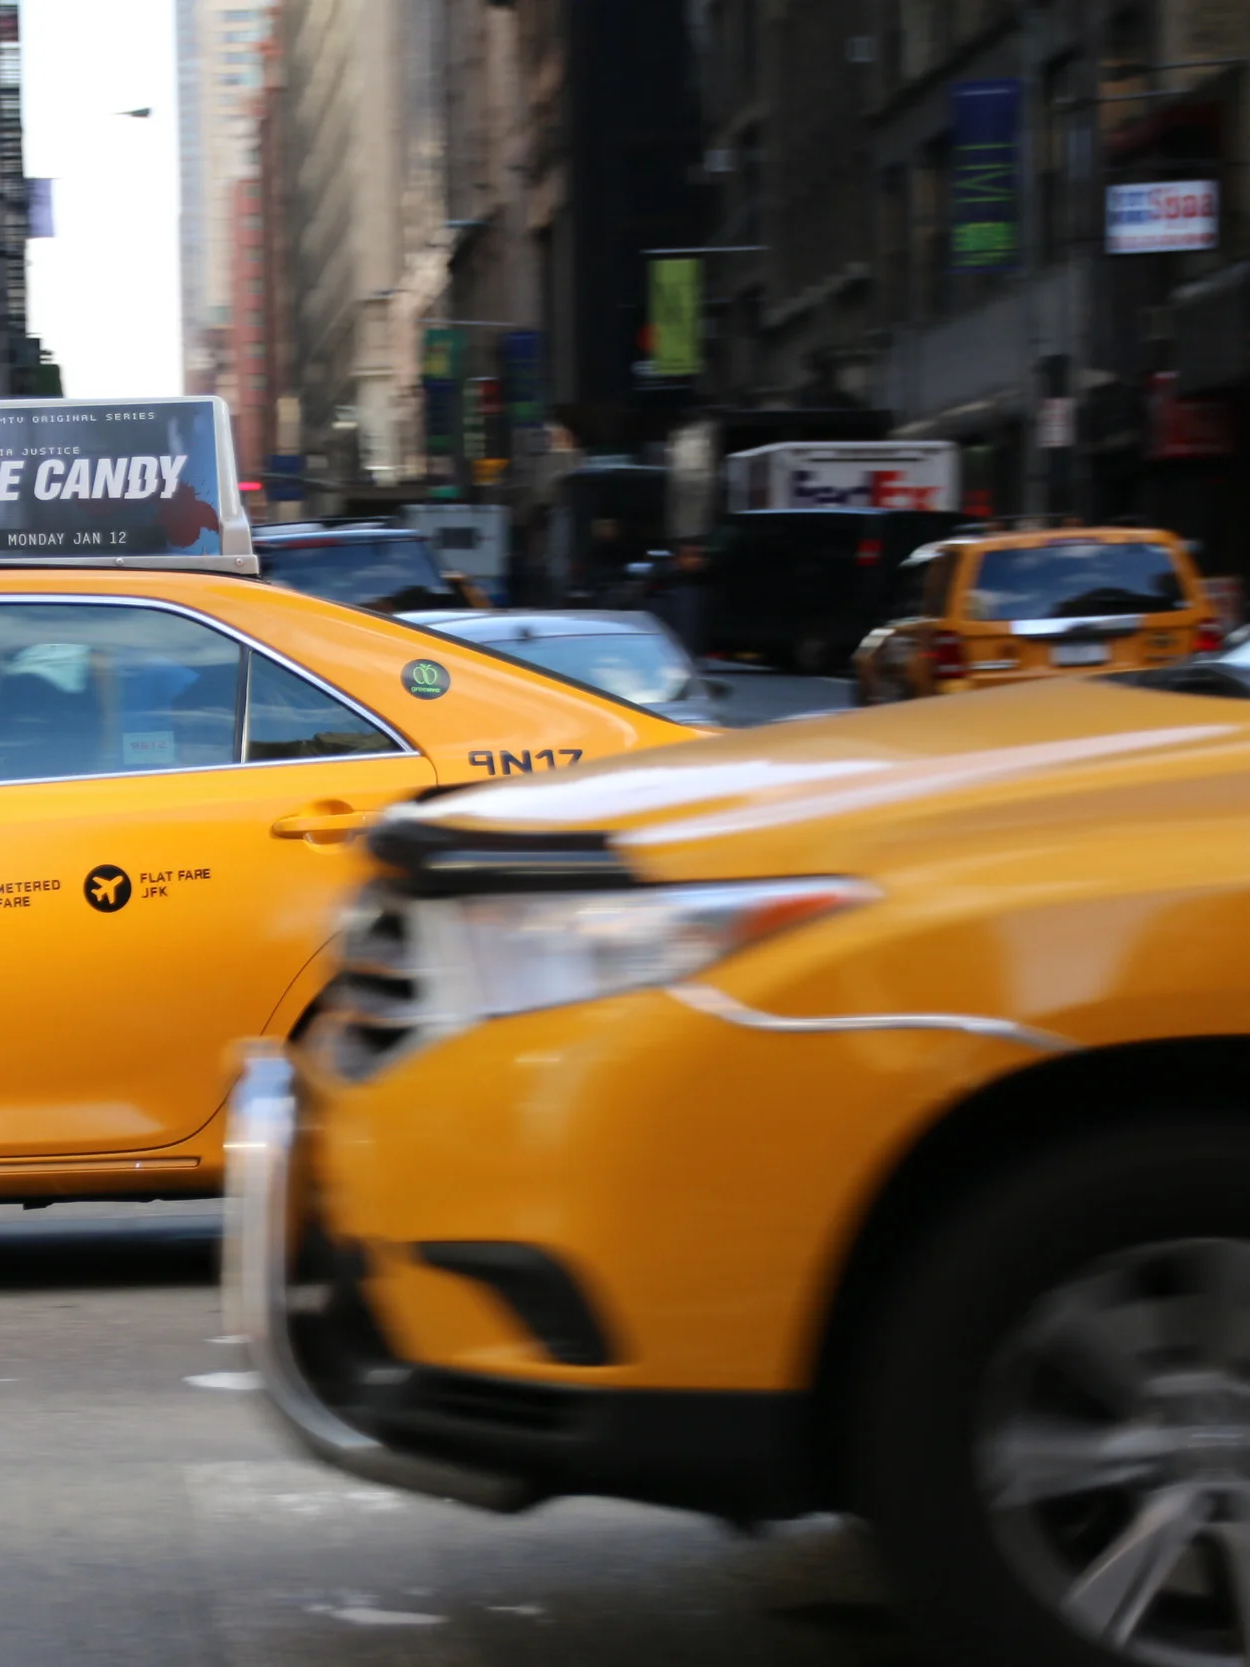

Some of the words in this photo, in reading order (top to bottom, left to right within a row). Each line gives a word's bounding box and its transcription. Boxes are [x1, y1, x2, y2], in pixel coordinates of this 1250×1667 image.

[32, 413, 97, 424] ORIGINAL
[105, 411, 156, 421] SERIES
[21, 446, 80, 457] JUSTICE
[33, 455, 188, 501] CANDY
[8, 532, 65, 546] MONDAY
[73, 532, 101, 545] JAN
[110, 531, 127, 544] 12
[468, 749, 583, 776] 9N17
[139, 870, 174, 884] FLAT
[177, 868, 211, 881] FARE
[141, 886, 169, 899] JFK
